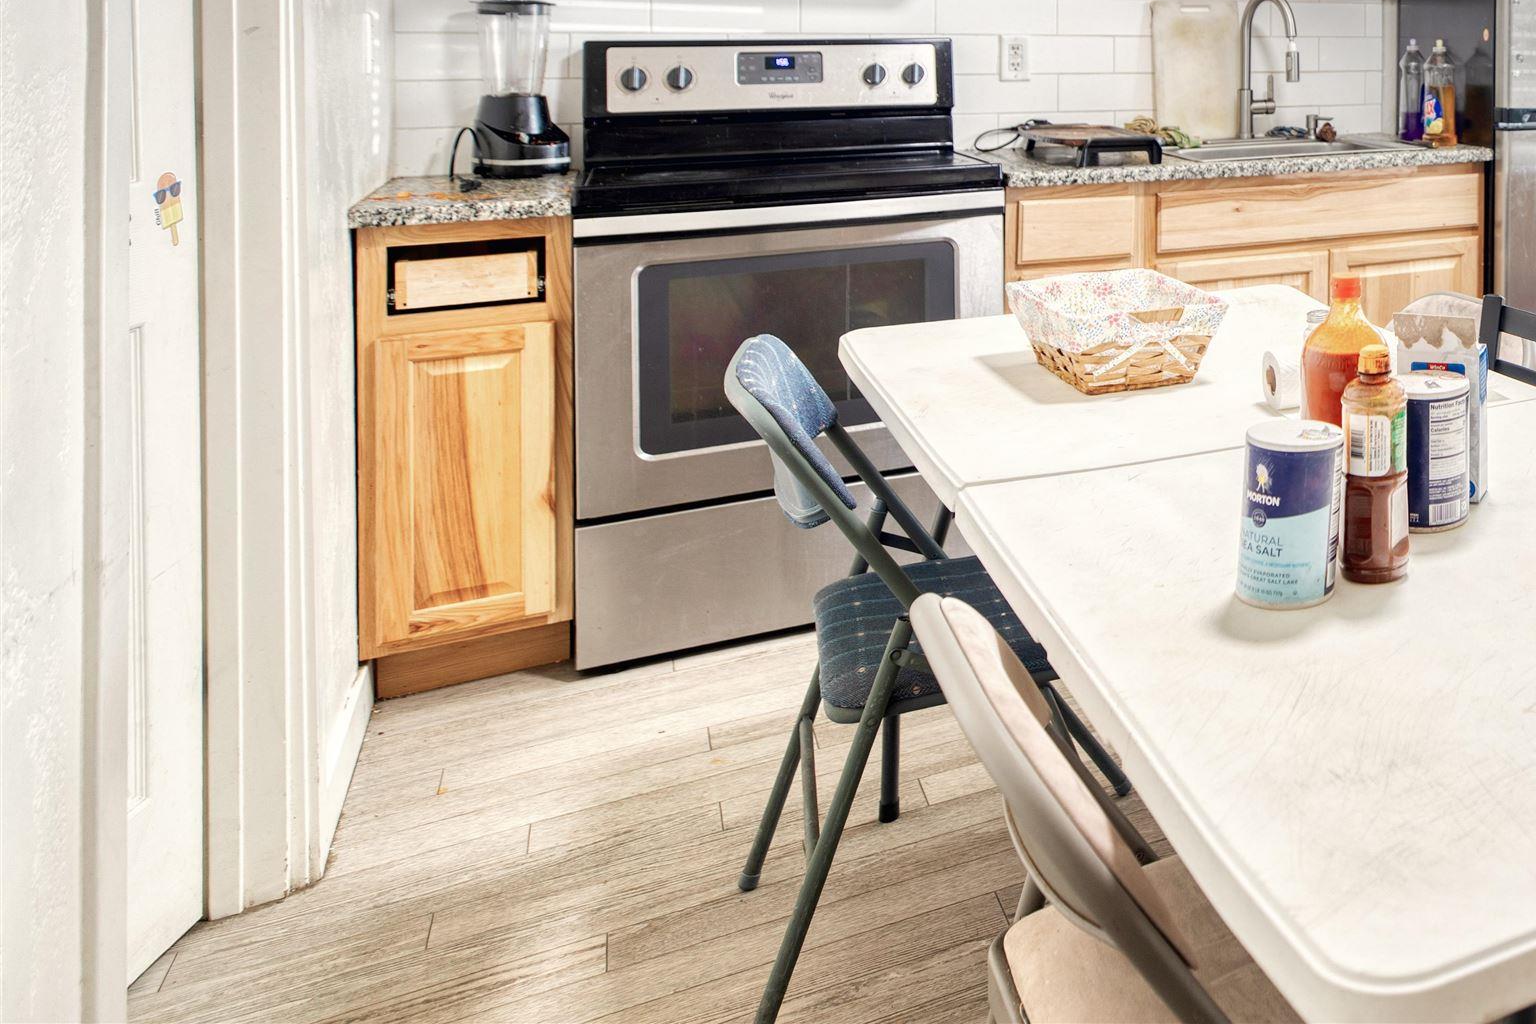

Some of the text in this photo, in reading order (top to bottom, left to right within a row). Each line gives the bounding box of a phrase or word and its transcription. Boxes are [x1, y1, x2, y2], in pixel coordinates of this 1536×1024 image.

[1430, 400, 1455, 410] Nutrition
[1246, 491, 1280, 507] MORTON
[1255, 545, 1283, 558] SALT
